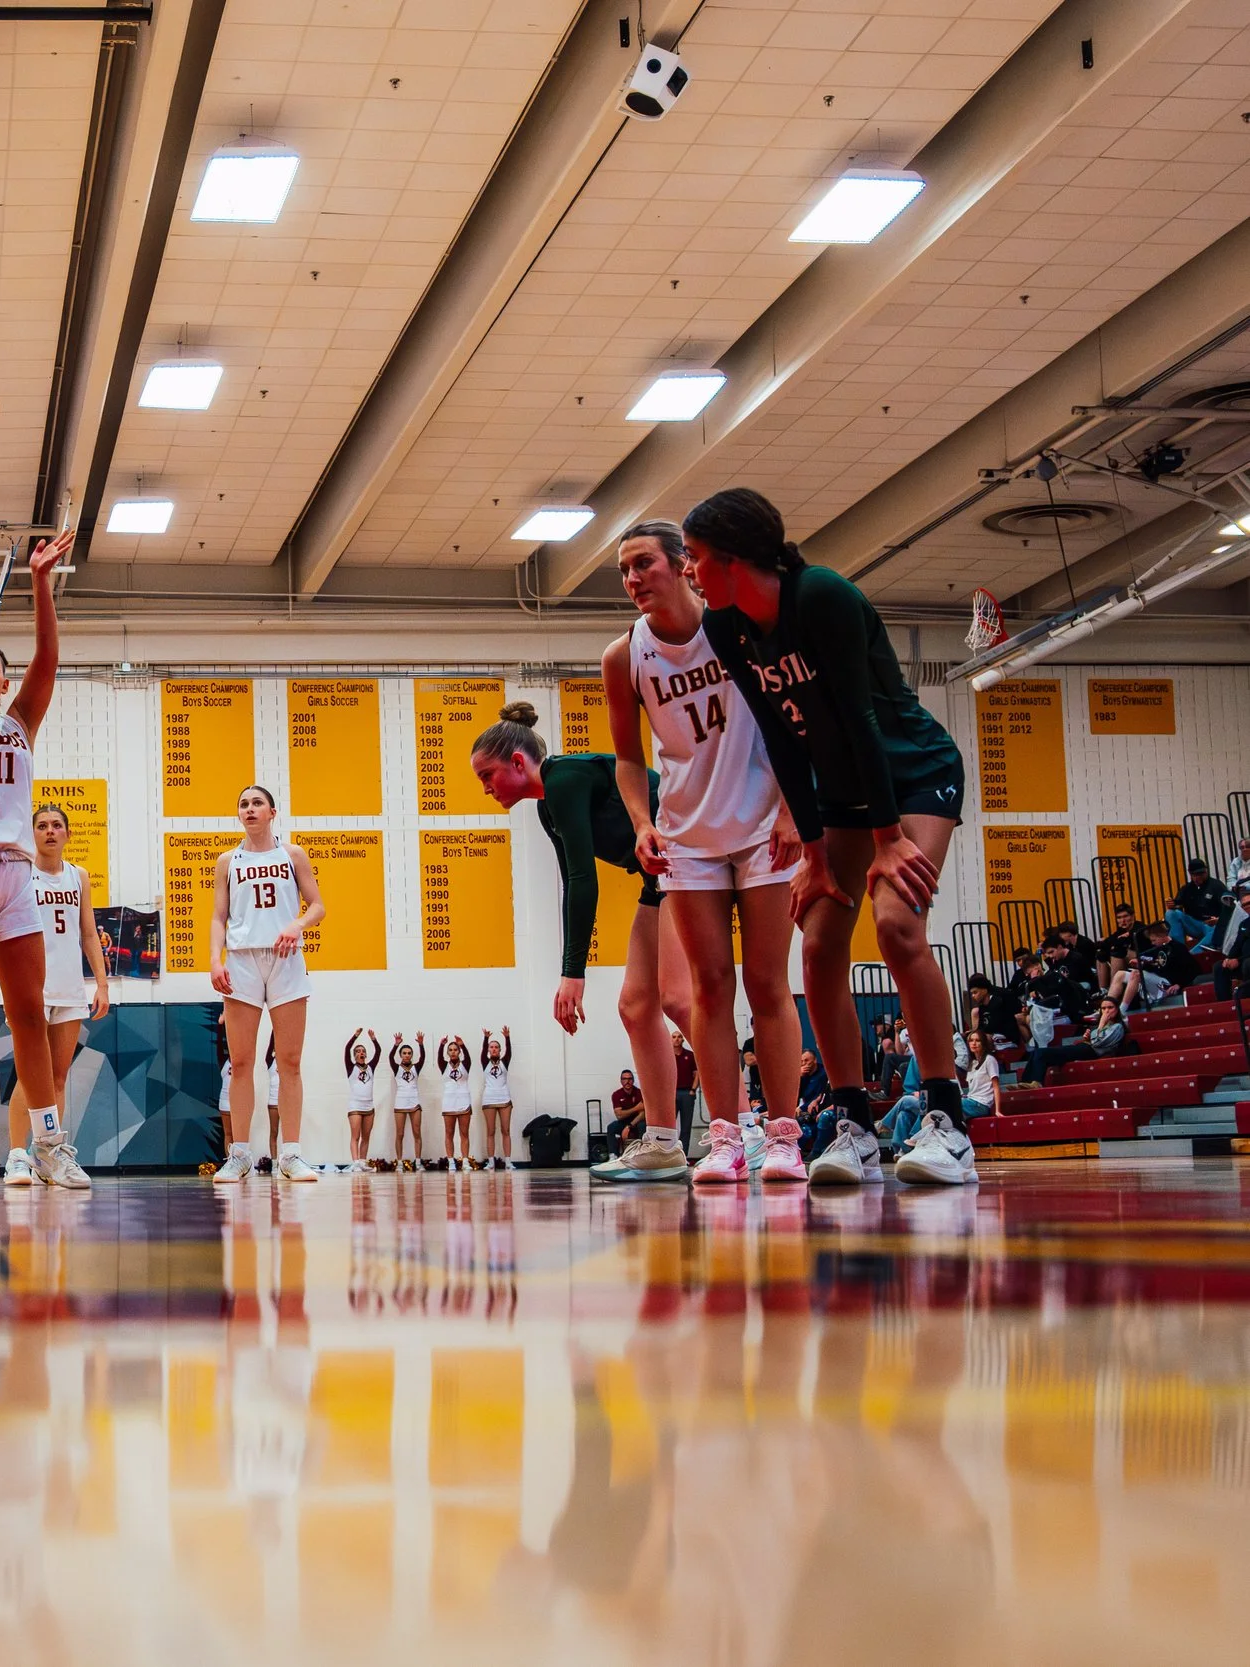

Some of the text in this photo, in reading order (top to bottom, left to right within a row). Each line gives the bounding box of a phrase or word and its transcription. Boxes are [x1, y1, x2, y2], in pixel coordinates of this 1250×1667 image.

[166, 683, 248, 694] CONFERENCE CHAMPIONS
[292, 682, 373, 693] CONFERENCE CHAMPIONS
[463, 681, 499, 692] CHAMPIONS
[1021, 683, 1056, 692] CHAMPIONS
[183, 696, 231, 706] BOYS SOCCER
[308, 696, 358, 706] GIRLS SOCCER
[443, 695, 477, 705] SOFTBALL
[583, 695, 602, 705] BOYS
[989, 695, 1051, 706] GIRLS GYMNASTICS
[1103, 695, 1121, 705] BOYS
[166, 714, 189, 722] 1987
[293, 714, 315, 722] 2001
[420, 712, 472, 721] 1987 2008
[566, 713, 588, 721] 1988
[683, 693, 726, 744] 14
[981, 713, 1003, 721] 1987
[1095, 712, 1116, 720] 1983
[167, 727, 190, 735] 1988
[293, 726, 316, 734] 2008
[420, 726, 443, 734] 1988
[566, 725, 588, 734] 1991
[982, 725, 1032, 733] 1991 2012
[167, 740, 190, 748] 1989
[293, 738, 316, 747] 2016
[420, 738, 443, 747] 1992
[566, 738, 589, 746] 2005
[983, 737, 1004, 746] 1992
[167, 752, 190, 761] 1996
[421, 751, 443, 759] 2001
[983, 750, 1005, 758] 1993
[167, 765, 190, 773] 2004
[421, 764, 444, 772] 2002
[983, 762, 1006, 770] 2000
[166, 778, 190, 786] 2008
[421, 776, 445, 785] 2003
[984, 774, 1006, 783] 2003
[42, 786, 85, 796] RMHS
[422, 789, 445, 798] 2005
[985, 787, 1007, 795] 2004
[67, 801, 97, 813] Song
[422, 802, 446, 810] 2006
[986, 800, 1008, 808] 2005
[988, 828, 1065, 839] CONFERENCE CHAMPIONS
[1102, 828, 1141, 838] CONFERENCE
[169, 836, 211, 847] CONFERENCE
[296, 834, 378, 845] CONFERENCE CHAMPIONS
[424, 833, 505, 844] CONFERENCE CHAMPIONS
[443, 847, 488, 857] BOYS TENNIS
[1007, 842, 1046, 853] GIRLS GOLF
[183, 850, 201, 860] BOYS
[309, 848, 366, 858] GIRLS SWIMMING
[989, 859, 1011, 868] 1998
[169, 868, 192, 877] 1980
[236, 863, 289, 884] LOBOS
[425, 865, 448, 874] 1983
[990, 872, 1012, 881] 1999
[169, 881, 192, 889] 1981
[425, 878, 448, 886] 1989
[990, 885, 1013, 894] 2005
[36, 890, 78, 906] LOBOS
[169, 894, 193, 902] 1986
[253, 883, 276, 908] 13
[426, 891, 448, 899] 1990
[170, 907, 193, 915] 1987
[426, 904, 448, 912] 1991
[55, 910, 65, 933] 5
[170, 920, 193, 928] 1988
[426, 916, 450, 925] 1993
[170, 933, 193, 941] 1990
[427, 929, 450, 938] 2006
[170, 946, 193, 954] 1991
[427, 942, 450, 951] 2007
[171, 959, 194, 968] 1992
